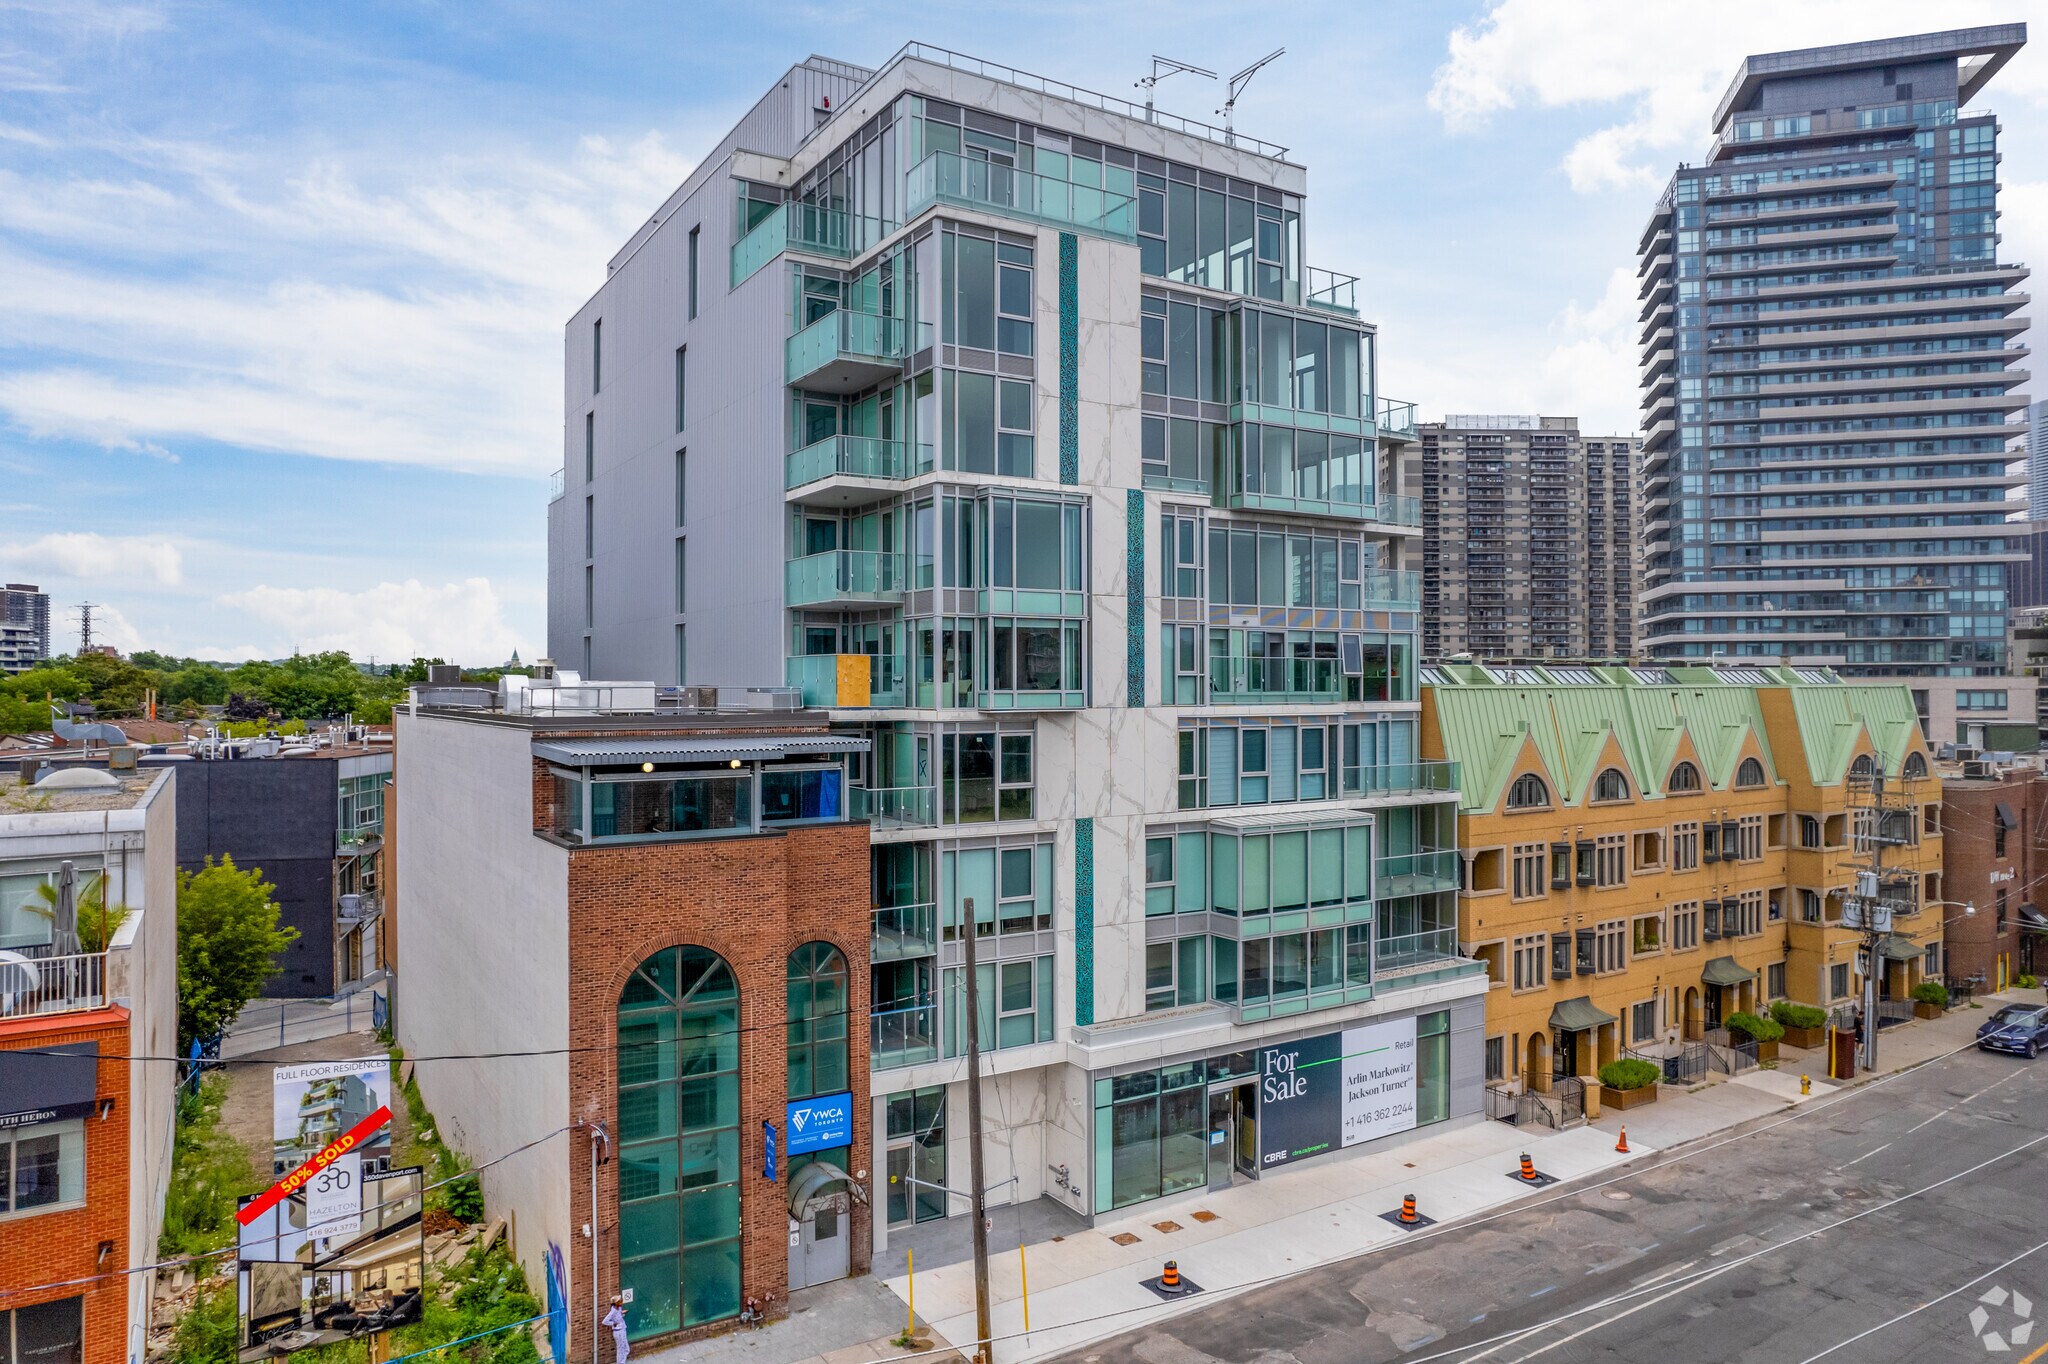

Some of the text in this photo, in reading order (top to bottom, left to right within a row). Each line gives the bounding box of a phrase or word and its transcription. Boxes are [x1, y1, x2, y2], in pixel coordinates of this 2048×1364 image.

[1395, 1038, 1414, 1050] Retail
[276, 1060, 387, 1080] FULL FLOOR RESIDENCES
[1264, 1049, 1299, 1077] For
[1346, 1073, 1368, 1086] Arlin
[1264, 1070, 1307, 1104] Sale
[1348, 1088, 1379, 1103] Jackson
[21, 1110, 56, 1122] HERON
[812, 1107, 844, 1121] YWCA
[1345, 1116, 1354, 1127] +1
[1357, 1112, 1372, 1125] 416
[1374, 1107, 1390, 1121] 362
[1392, 1102, 1413, 1117] 2244
[814, 1117, 844, 1127] TORONTO
[1264, 1149, 1287, 1163] CBRE
[280, 1135, 355, 1193] 50% SOLD
[363, 1168, 418, 1182] 350davenport.com
[309, 1202, 357, 1216] HAZELTON
[309, 1222, 358, 1237] 416 924 3779
